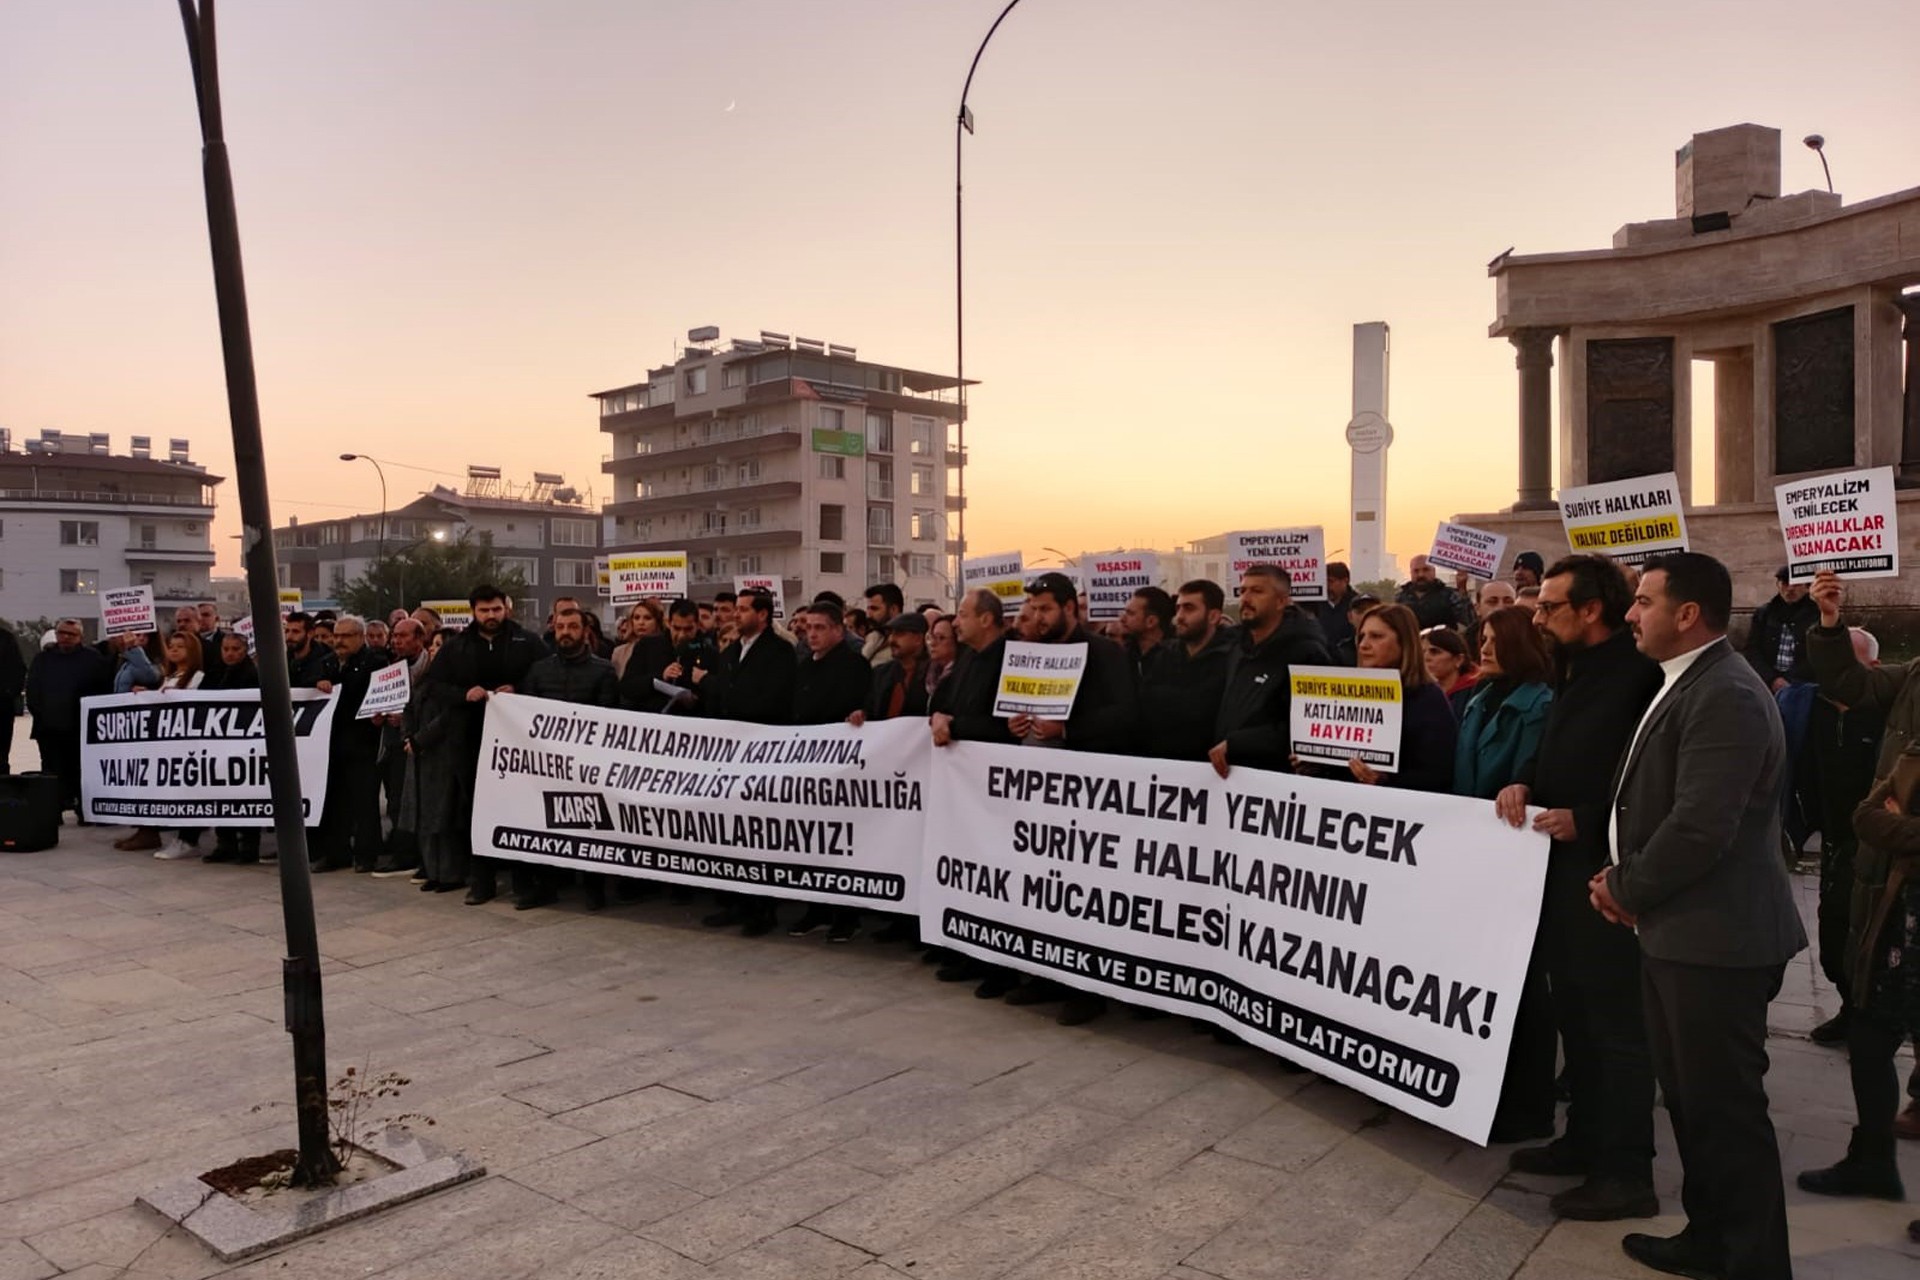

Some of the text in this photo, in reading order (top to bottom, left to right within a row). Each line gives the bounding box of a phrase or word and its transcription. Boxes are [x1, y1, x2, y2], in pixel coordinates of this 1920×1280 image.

[1785, 478, 1869, 505] EMPERYALİZM
[1564, 489, 1673, 519] SURİYE HALKLARI
[1792, 498, 1859, 520] YENİLECEK
[1574, 520, 1674, 547] YALNIZ DEĞİLDİR!
[1817, 515, 1884, 536] HALKLAR
[1240, 532, 1309, 546] EMPERYALİZM
[1792, 534, 1882, 558] KAZANACAK!
[1247, 546, 1301, 557] YENİLECEK
[619, 571, 675, 582] KATLİAMINA
[1096, 560, 1142, 574] YAŞASIN
[626, 581, 670, 592] HAYIR!
[1091, 575, 1150, 587] HALKLARIN
[1007, 652, 1083, 670] SURİYE HALKLARI
[1005, 680, 1036, 695] YALNIZ
[1296, 679, 1396, 701] SURİYE HALKLARININ
[157, 707, 305, 738] HALKLAI
[1303, 700, 1385, 725] KATLİAMINA
[529, 711, 868, 770] SURİYE HALKLARININ KATLİAMINA,
[1309, 723, 1374, 744] HAYIR!
[99, 758, 150, 787] YALNIZ
[491, 738, 923, 812] İŞGALLERE ve EMPERYALİST SALDIRGANLIĞA
[138, 803, 149, 816] VE
[150, 801, 218, 816] DEMOKRASİ
[221, 803, 300, 816] PLATFO
[988, 764, 1426, 867] EMPERYALİZM YENİLECEK
[552, 795, 855, 857] KARŞI MEYDANLARDAYIZ!
[497, 831, 899, 898] ANTAKYA EMEK VE DEMOKRASİ PLATFORMU
[1012, 819, 1369, 926] SURİYE HALKLARININ
[936, 853, 1500, 1042] ORTAK MÜCADELESİ KAZANACAK!
[945, 915, 1449, 1099] ANTAKYA EMEK VE DEMOKRASİ PLATFORMU
